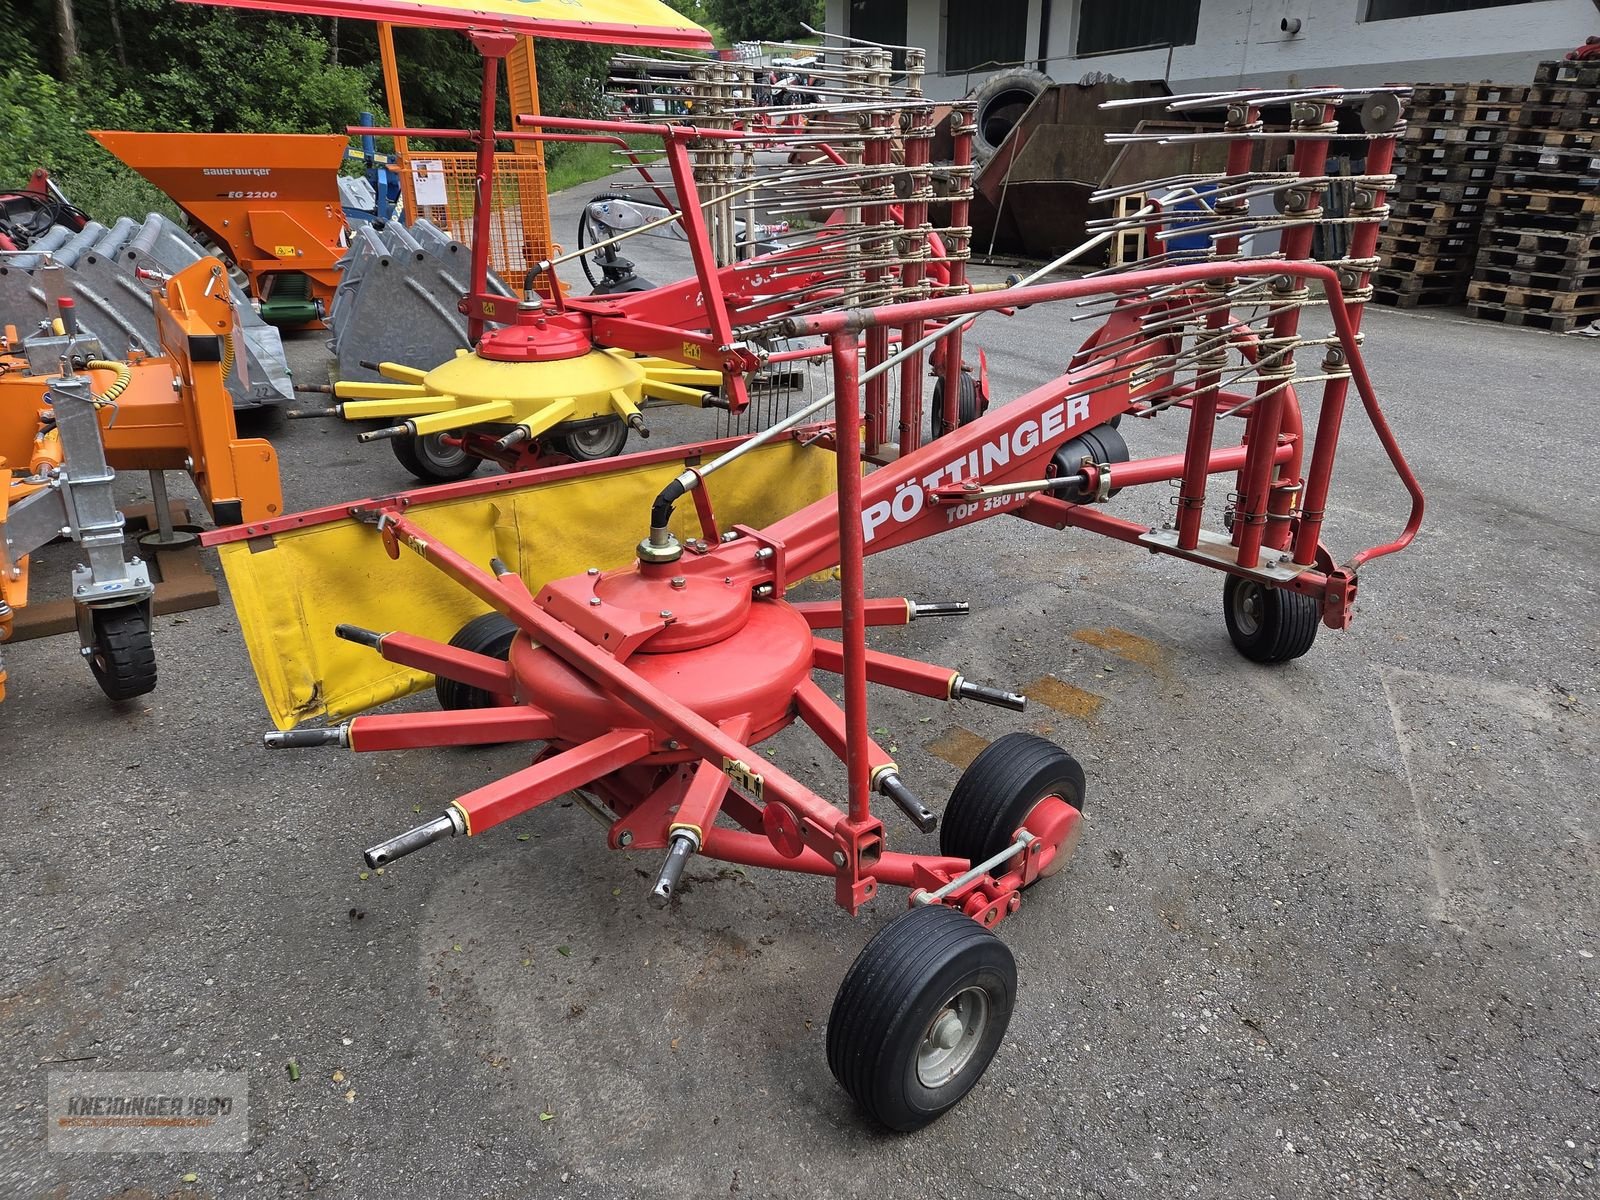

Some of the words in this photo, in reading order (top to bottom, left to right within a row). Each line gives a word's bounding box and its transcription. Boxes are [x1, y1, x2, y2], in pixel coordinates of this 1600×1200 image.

[861, 394, 1091, 543] PÖTTINGER
[946, 502, 979, 524] TOP
[983, 494, 1012, 512] 380
